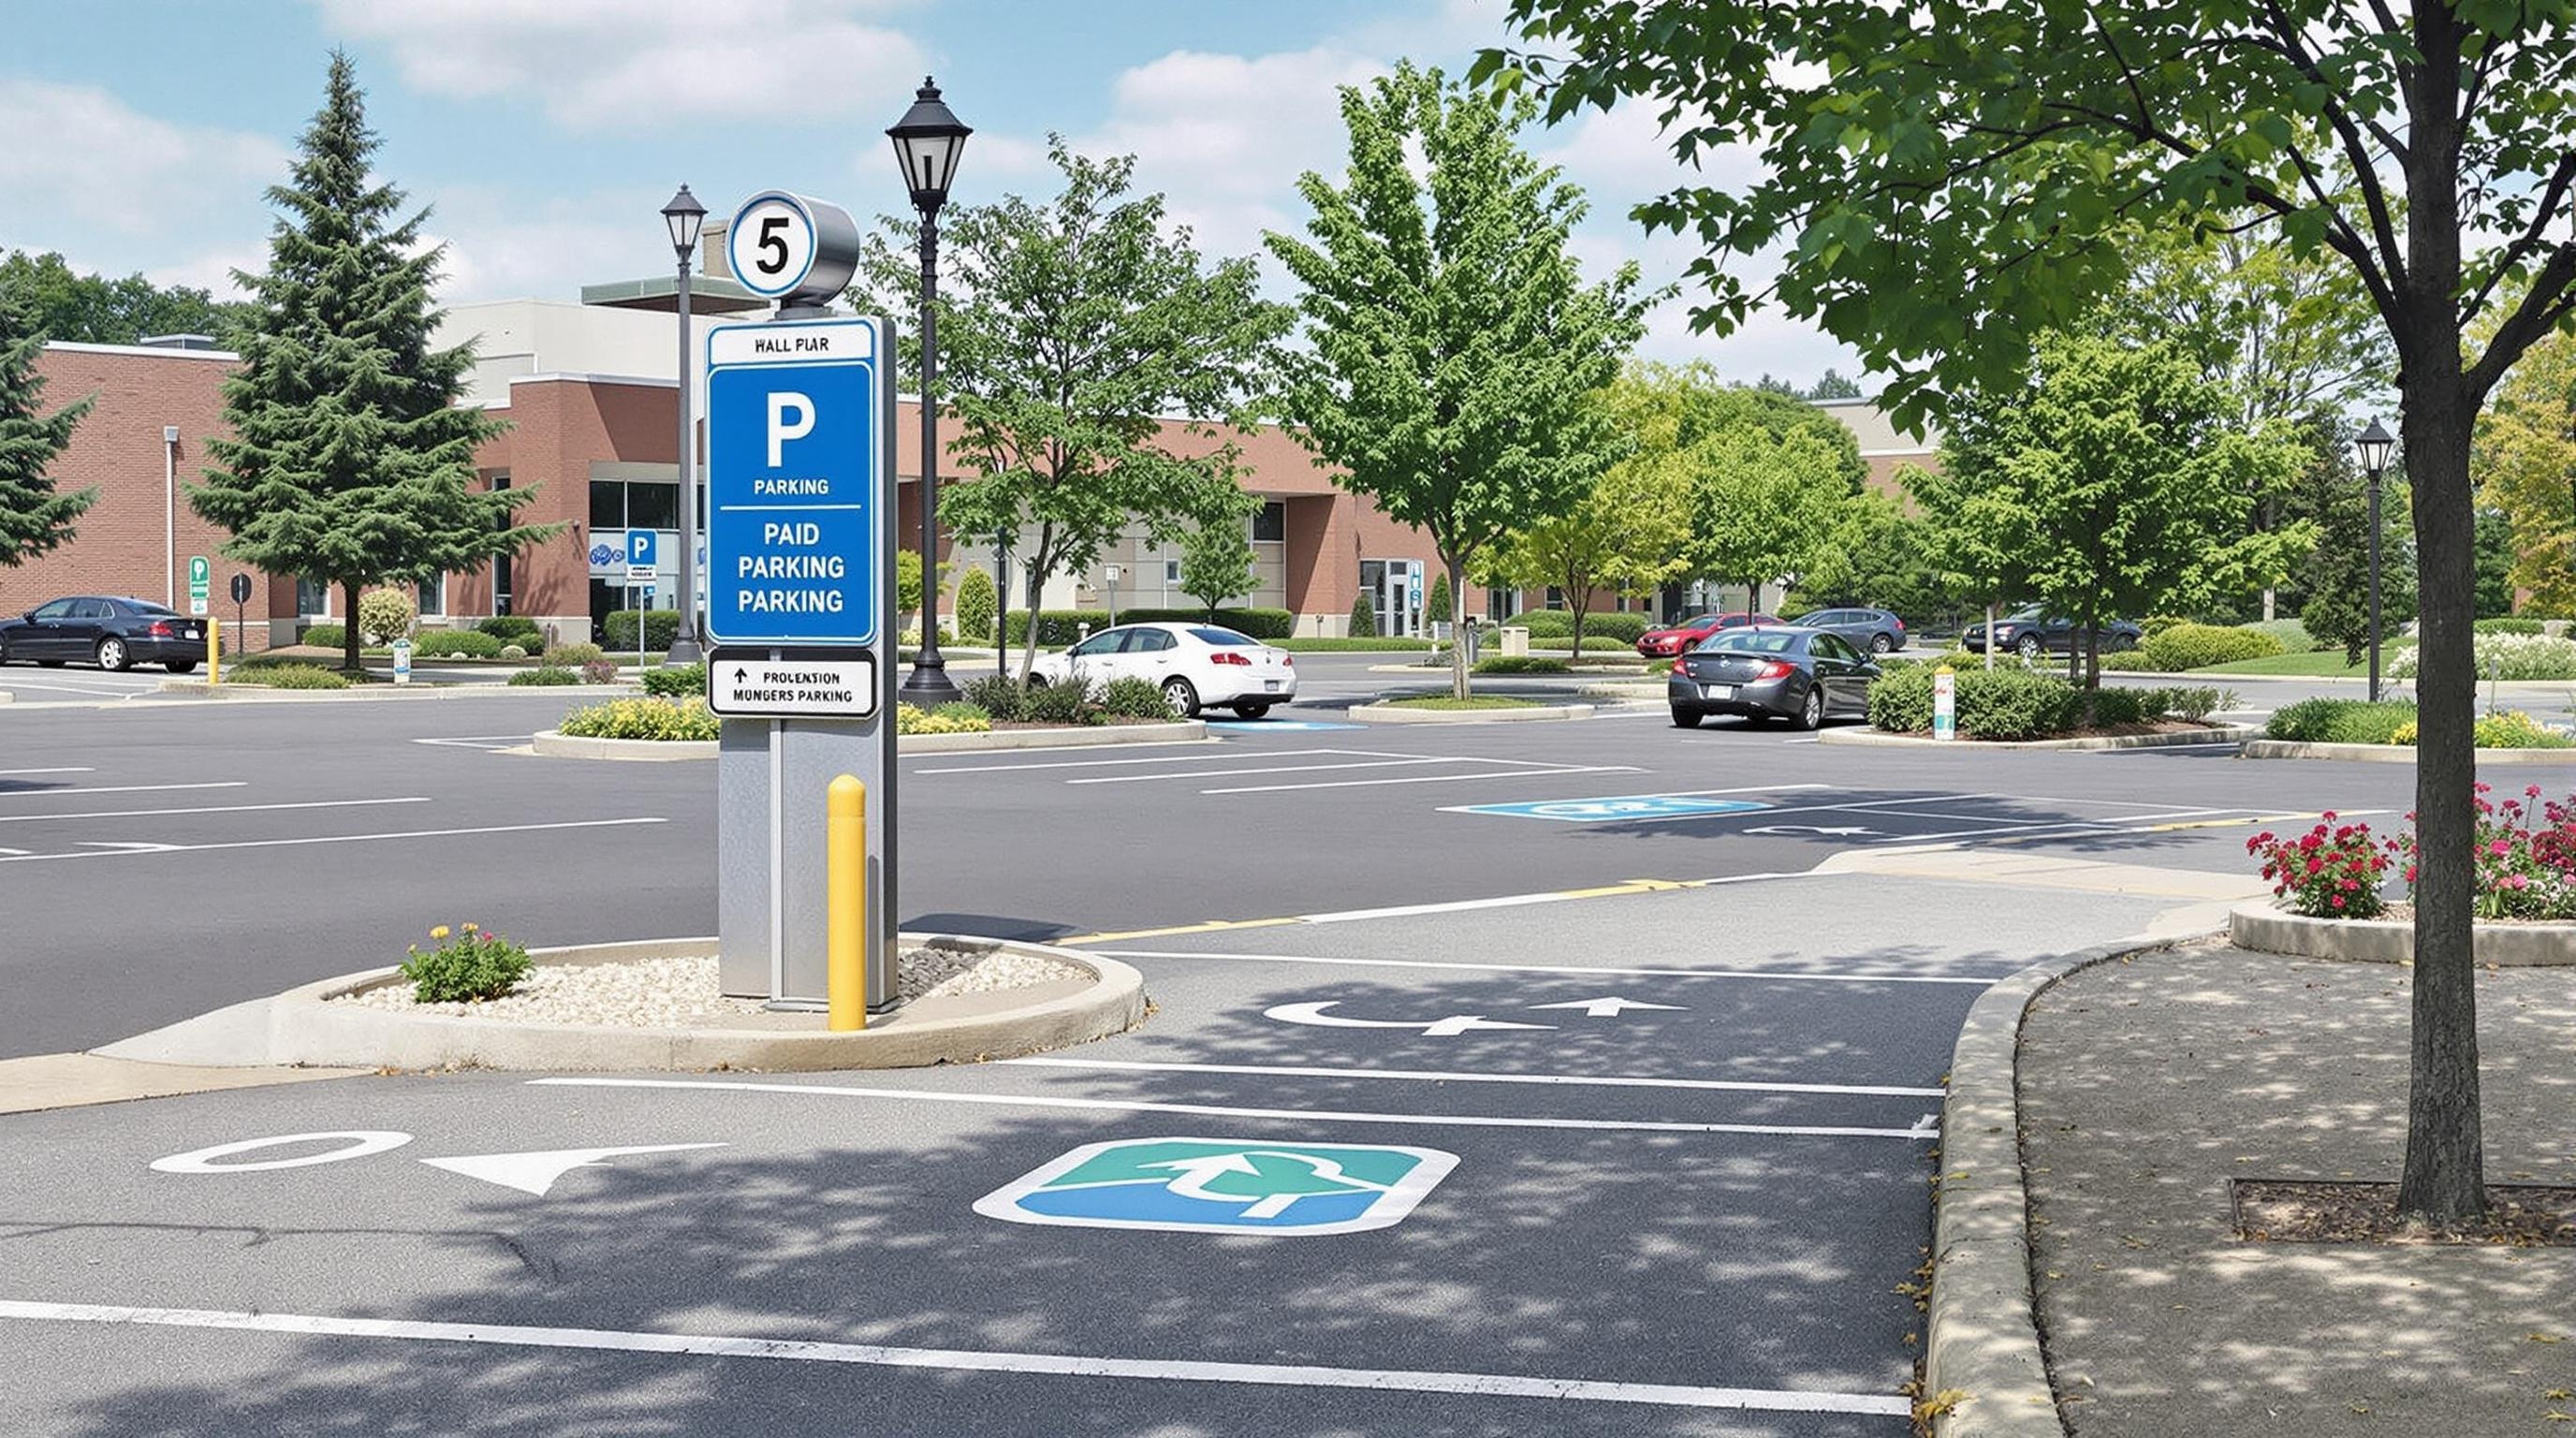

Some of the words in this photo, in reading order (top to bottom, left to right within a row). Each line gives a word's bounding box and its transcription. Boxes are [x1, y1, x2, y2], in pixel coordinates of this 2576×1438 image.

[756, 217, 790, 274] 5
[768, 391, 816, 467] P
[754, 479, 829, 495] PARKING
[765, 523, 820, 545] PAID
[634, 536, 649, 559] P
[739, 556, 844, 579] PARKING
[739, 590, 843, 612] PARKING
[798, 690, 853, 702] PARKING
